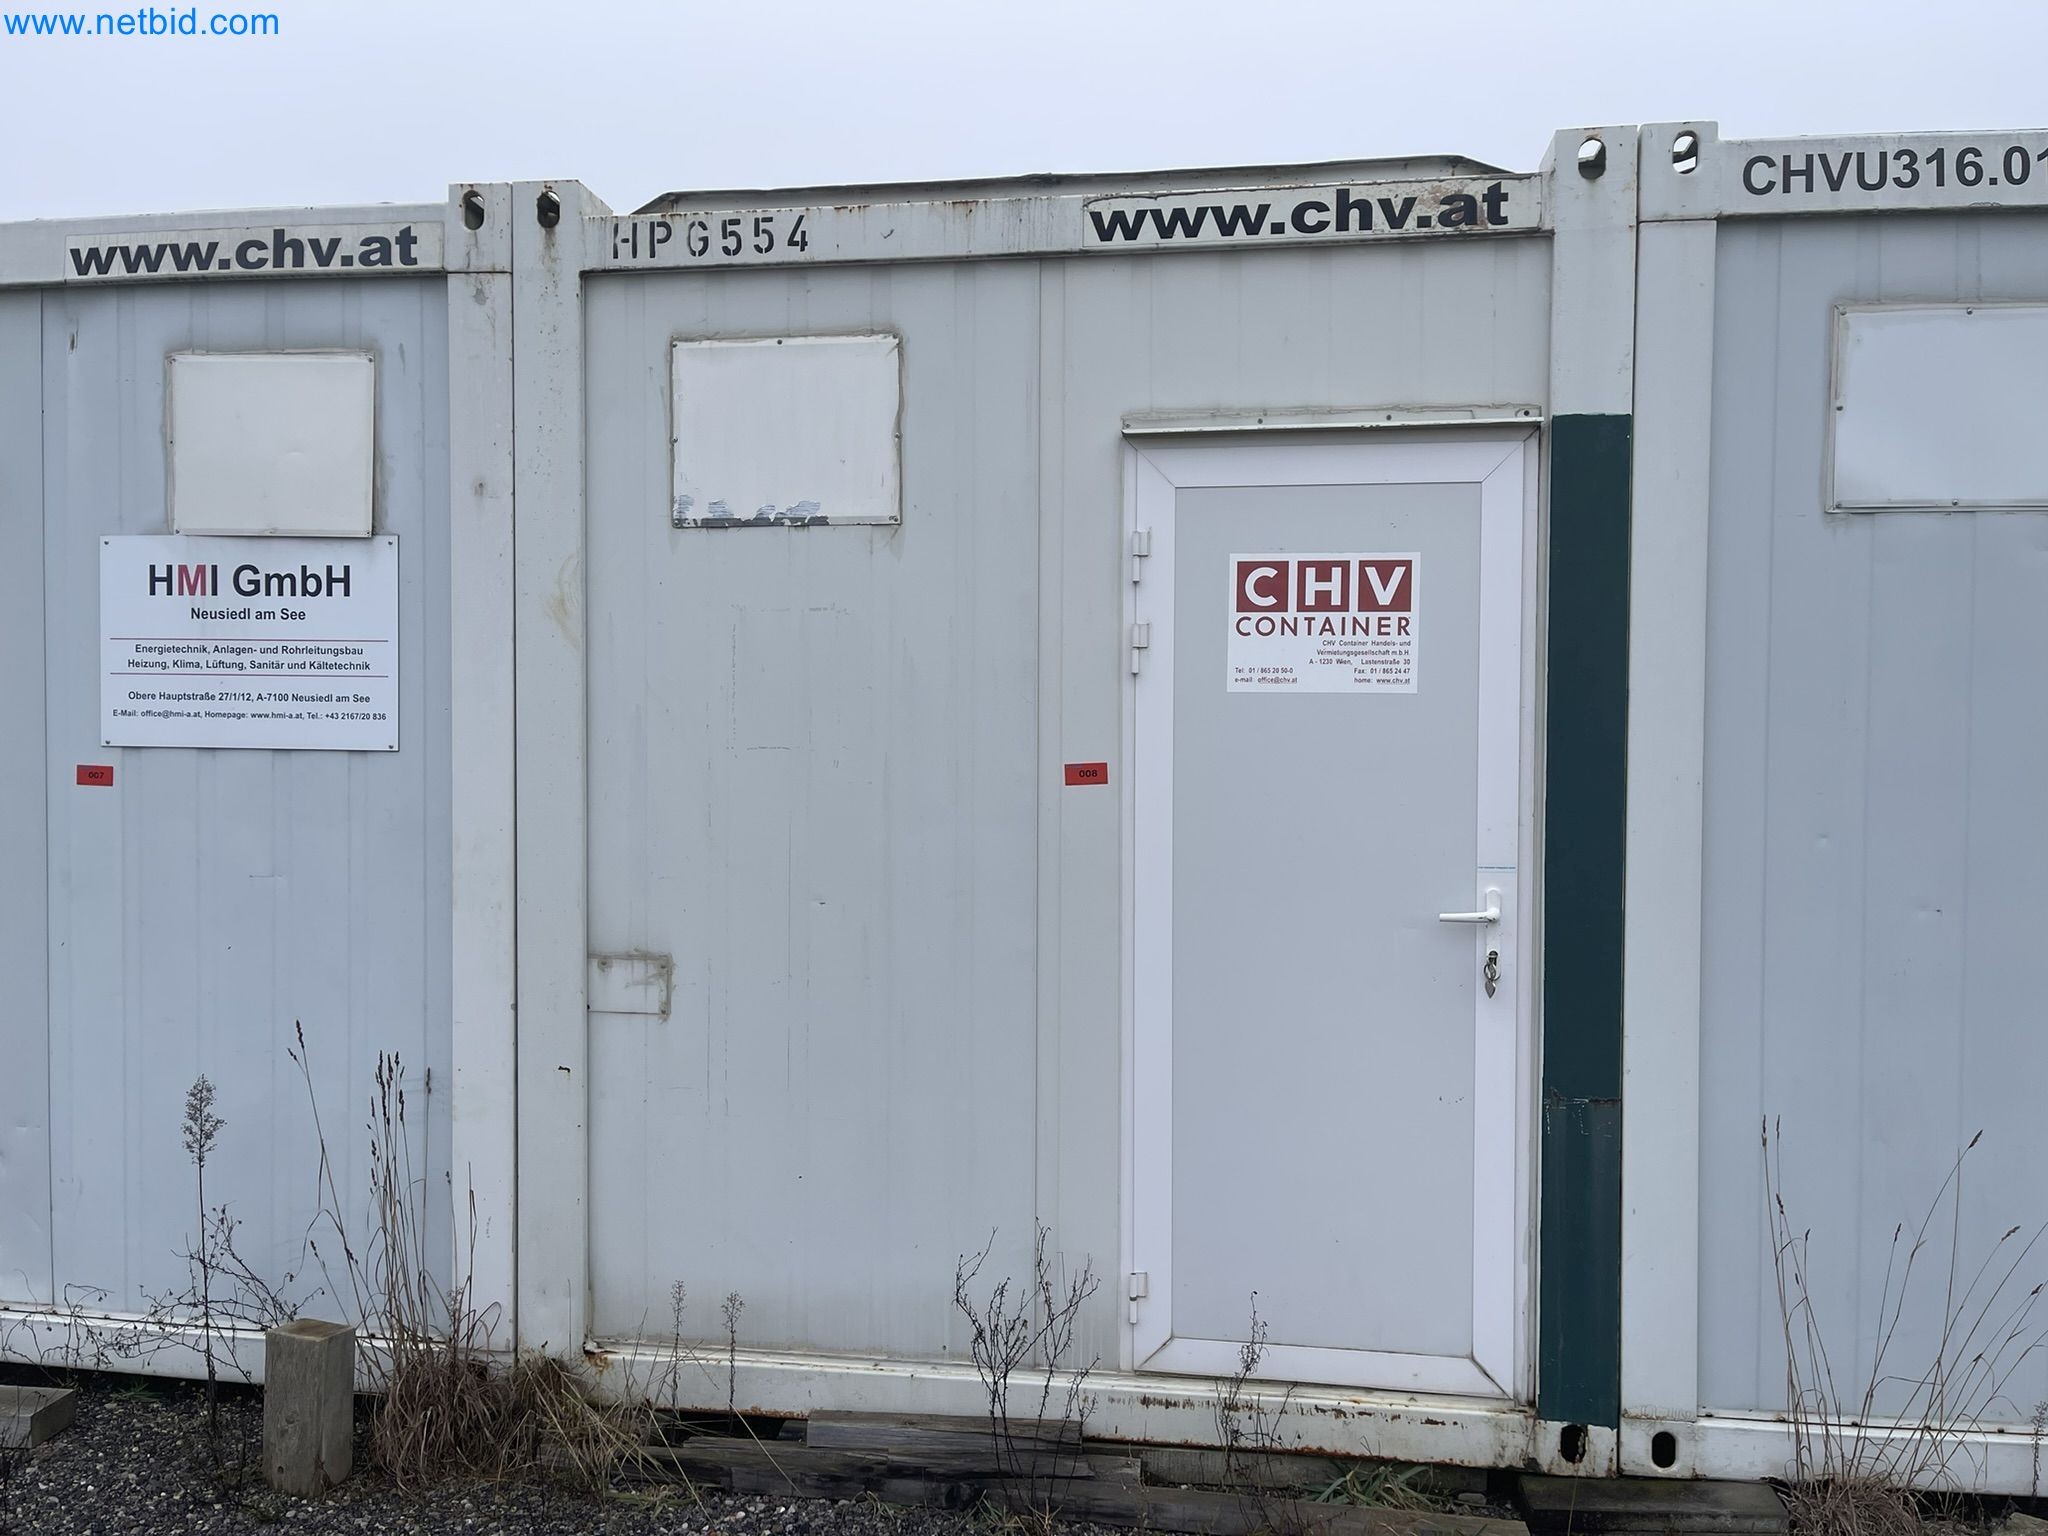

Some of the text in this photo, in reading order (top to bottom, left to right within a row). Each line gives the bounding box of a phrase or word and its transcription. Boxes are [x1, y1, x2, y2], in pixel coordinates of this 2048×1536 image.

[1742, 145, 2048, 196] CHVU316.0
[1089, 181, 1509, 243] www.chv.at
[69, 225, 418, 276] www.chv.at
[148, 564, 351, 597] HMI GmbH
[1244, 566, 1407, 607] CHV
[190, 607, 306, 621] Neusiedl am See
[1235, 615, 1411, 637] CONTAINER
[135, 644, 363, 657] Energietechnik, Anlagen- und Rohrleitungsbau
[1316, 648, 1391, 657] Vermietungsgesellschaft
[127, 660, 371, 671] Heizung, Klima, Lüftung, Sanitär und Kältetechnik
[128, 692, 370, 703] Obere Hauptstraße 27/1/12, A-7100 Neusiedl am See
[112, 709, 138, 718] E-Mail:
[204, 711, 248, 721] Homepage:
[325, 713, 339, 721] +43
[341, 712, 370, 721] 2167/20
[372, 713, 387, 721] 836
[88, 771, 105, 779] 007
[1078, 769, 1098, 778] 008
